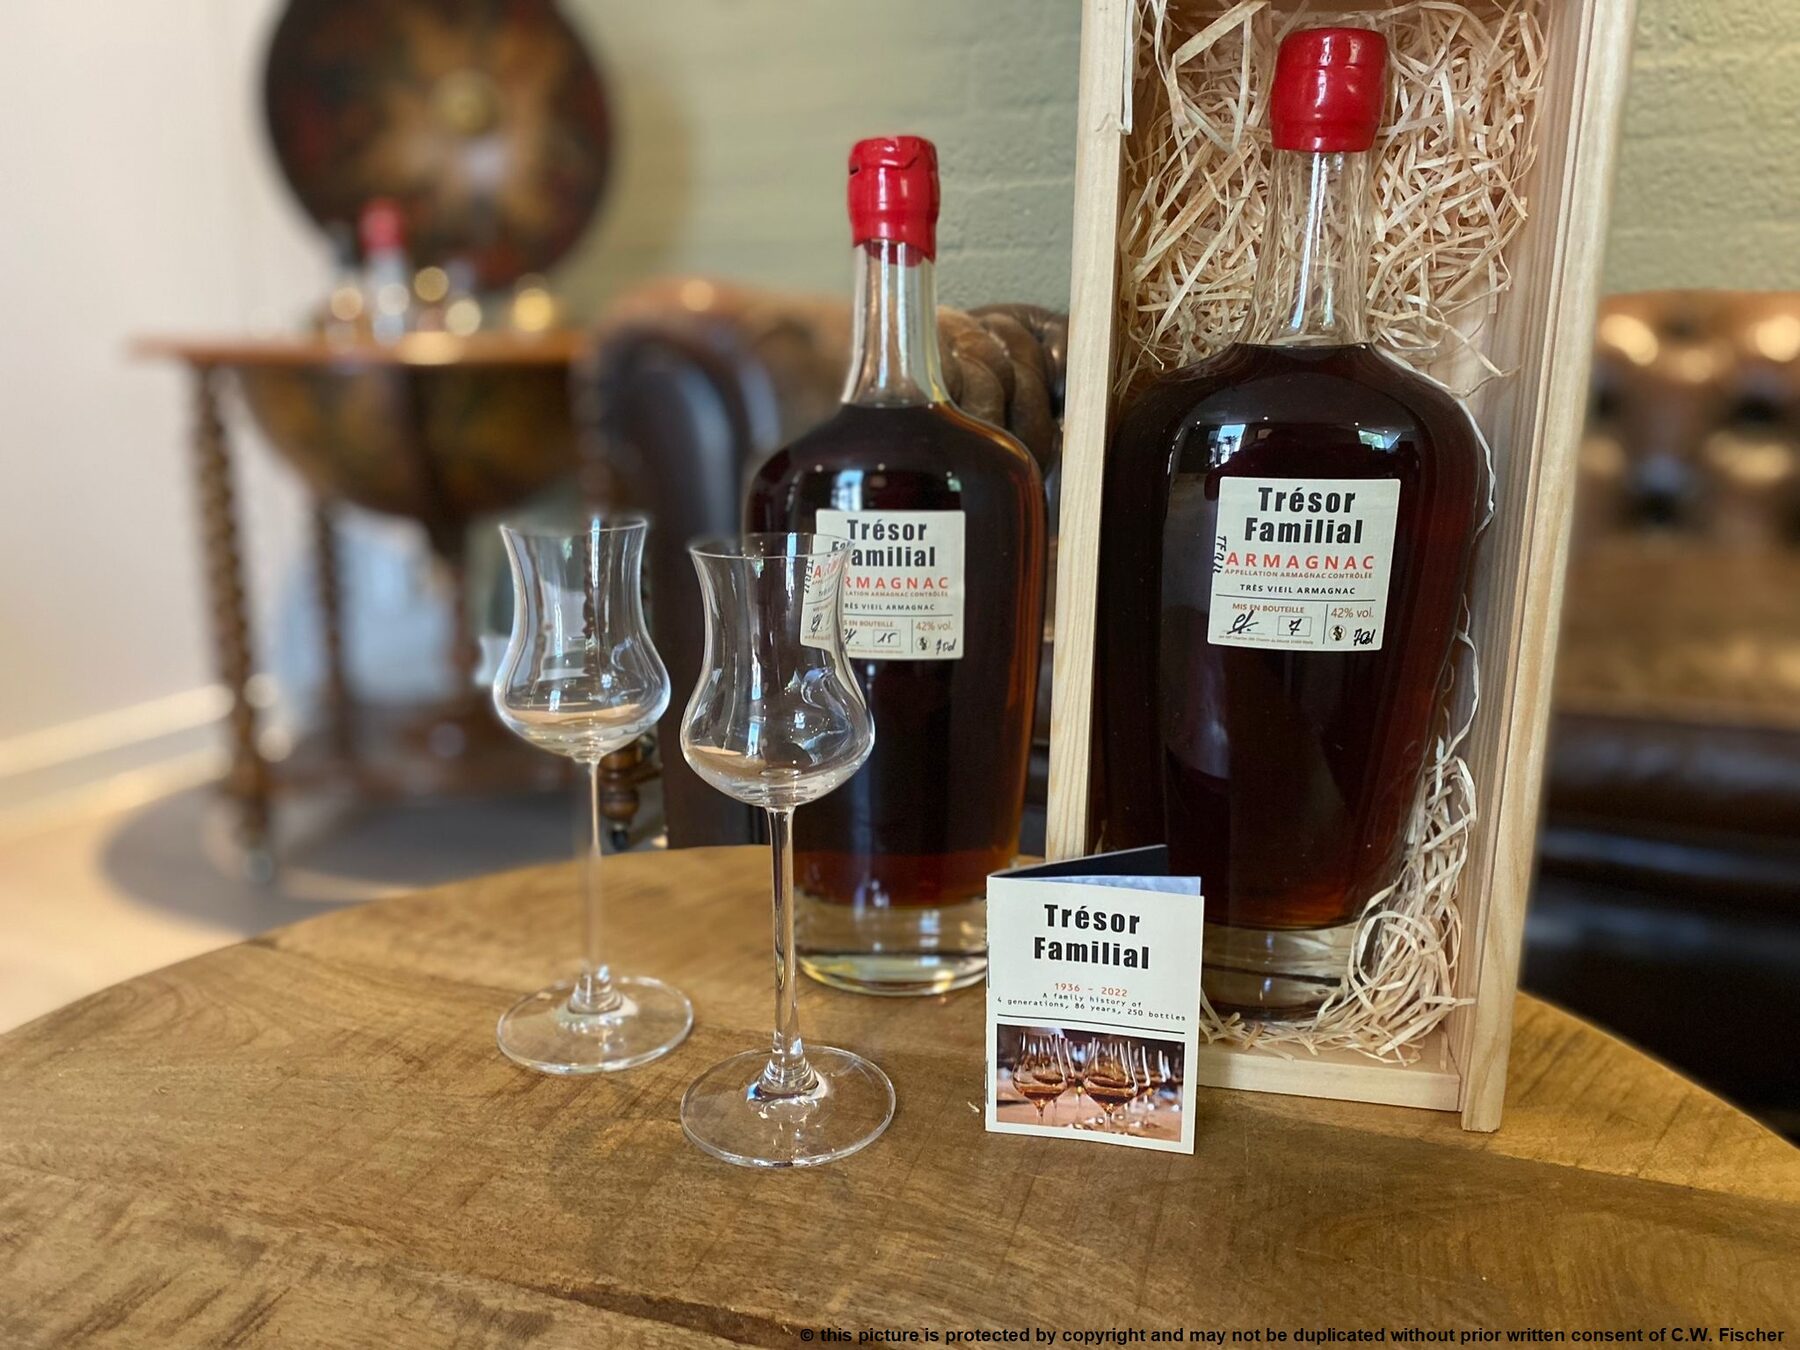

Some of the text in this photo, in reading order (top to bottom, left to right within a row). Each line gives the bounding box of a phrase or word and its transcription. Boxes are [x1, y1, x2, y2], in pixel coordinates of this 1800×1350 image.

[1258, 487, 1356, 513] Trésor
[847, 519, 927, 541] Trésor
[1244, 518, 1363, 544] Familial
[851, 547, 936, 567] amilial
[1226, 552, 1375, 570] ARMAGNAC
[1224, 569, 1278, 577] APPELLATION
[1280, 571, 1326, 579] ARMAGNAC
[845, 576, 949, 589] RMAGNAC
[1267, 585, 1293, 593] VIEIL
[1296, 587, 1356, 595] ARMAGNAC
[1262, 605, 1305, 614] BOUTEILLE
[1331, 607, 1354, 618] 42%
[915, 621, 935, 631] 42%
[877, 632, 898, 644] 15
[1044, 904, 1141, 935] Trésor
[1034, 937, 1150, 970] Familial
[1055, 982, 1080, 992] 1936
[1101, 986, 1128, 997] 2022
[1054, 993, 1084, 1002] family
[1089, 996, 1126, 1007] history
[1007, 999, 1069, 1010] generations,
[1074, 1002, 1085, 1010] 86
[1090, 1005, 1121, 1015] years,
[1127, 1008, 1144, 1017] 250
[1148, 1011, 1186, 1021] bottles
